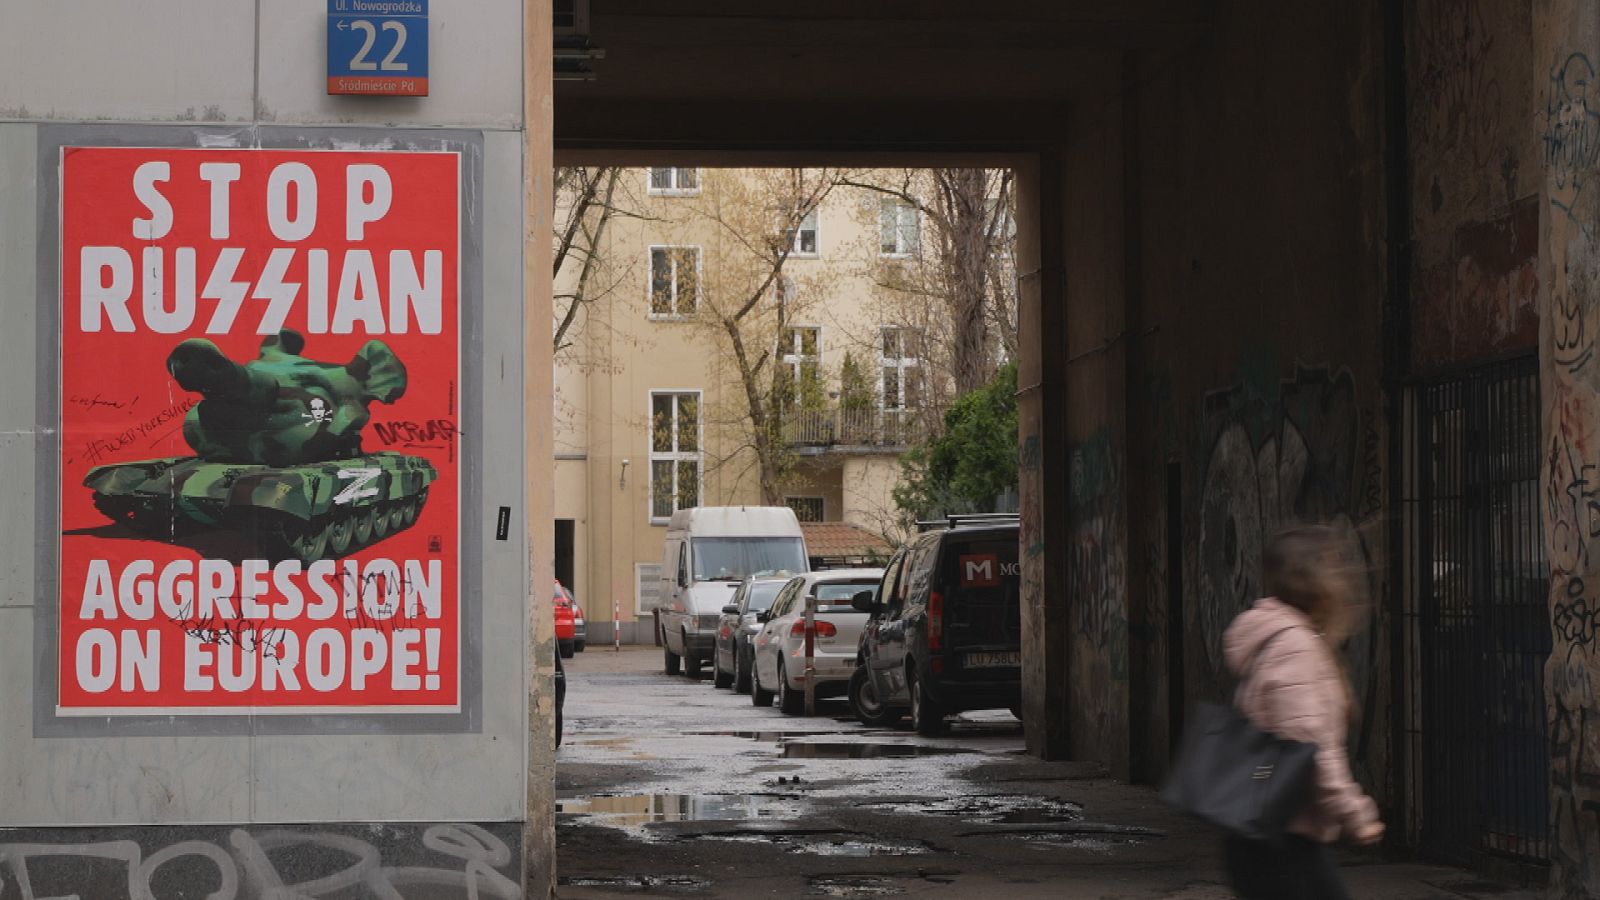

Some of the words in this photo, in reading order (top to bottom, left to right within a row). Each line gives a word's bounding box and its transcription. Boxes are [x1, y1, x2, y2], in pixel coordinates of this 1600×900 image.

[353, 0, 422, 13] Nowogrodzka
[350, 20, 408, 71] 22
[132, 161, 393, 241] STOP
[80, 246, 443, 335] RUSSIAN
[79, 558, 442, 621] AGGRESSION
[75, 628, 161, 693] ON
[184, 628, 442, 693] EUROPE!
